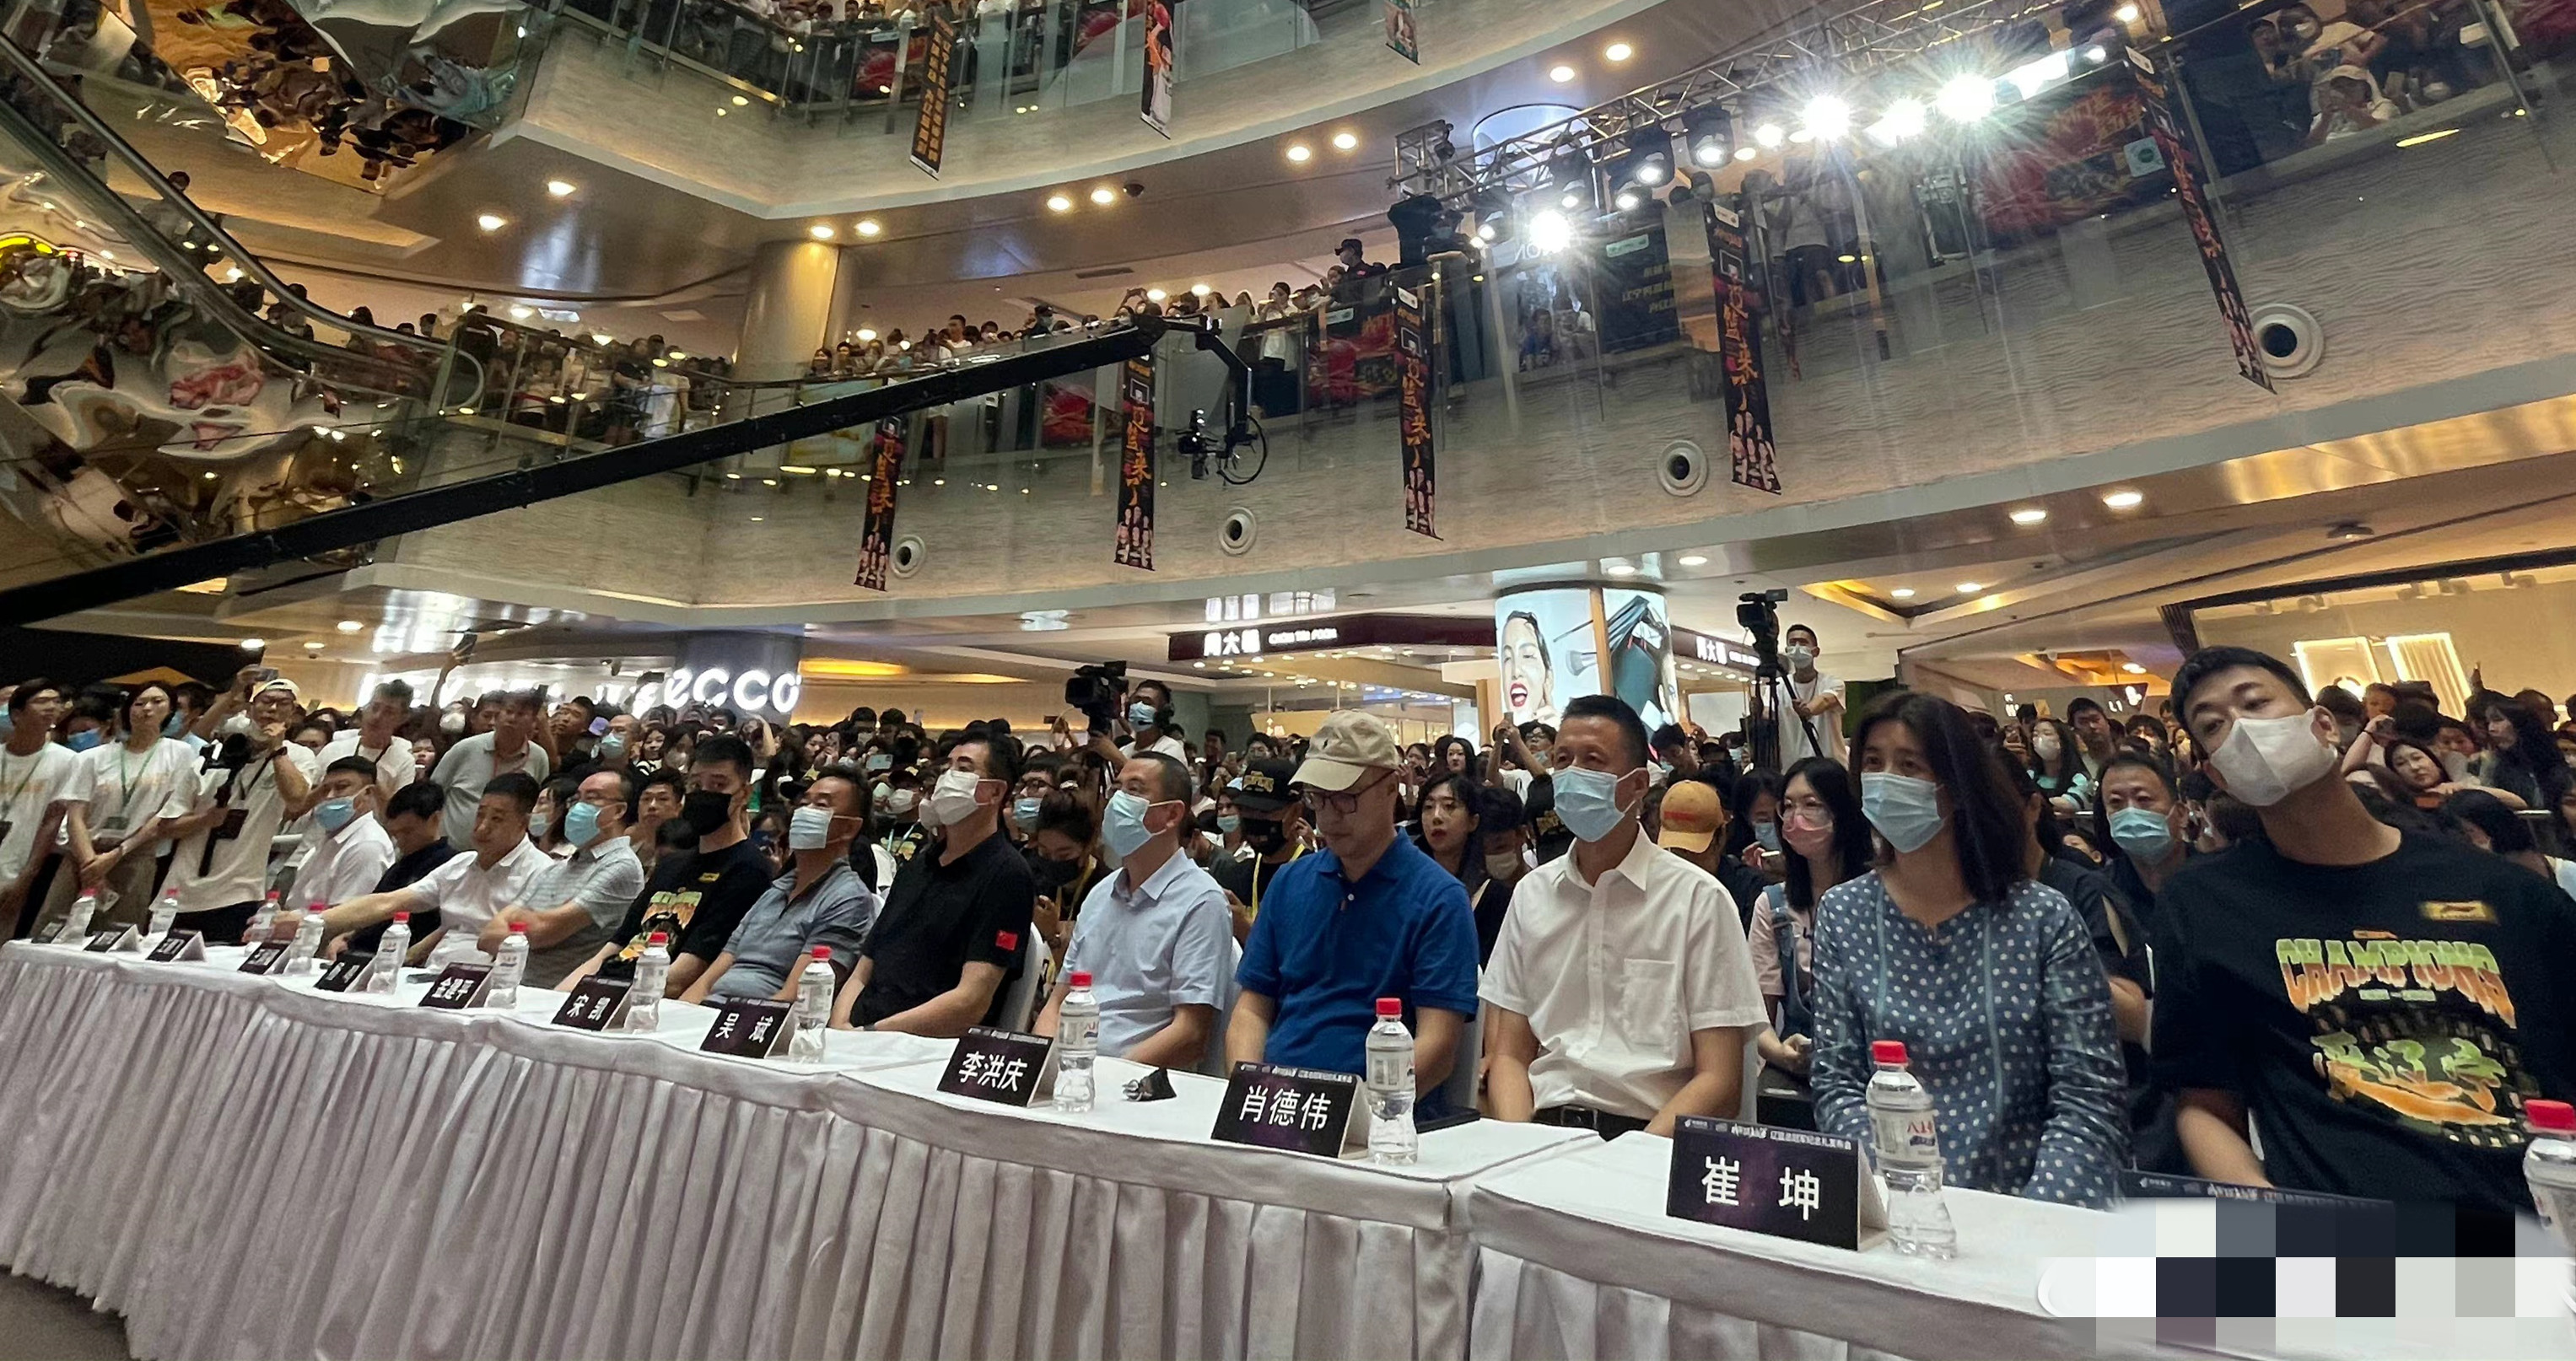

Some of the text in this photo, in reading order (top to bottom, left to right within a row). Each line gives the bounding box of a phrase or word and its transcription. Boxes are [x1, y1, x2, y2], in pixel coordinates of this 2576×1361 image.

[2276, 938, 2517, 1030] CHAMPIONS
[958, 1051, 1028, 1093] 李洪庆
[1238, 1085, 1332, 1132] 肖德伟
[1701, 1155, 1820, 1221] 崔坤
